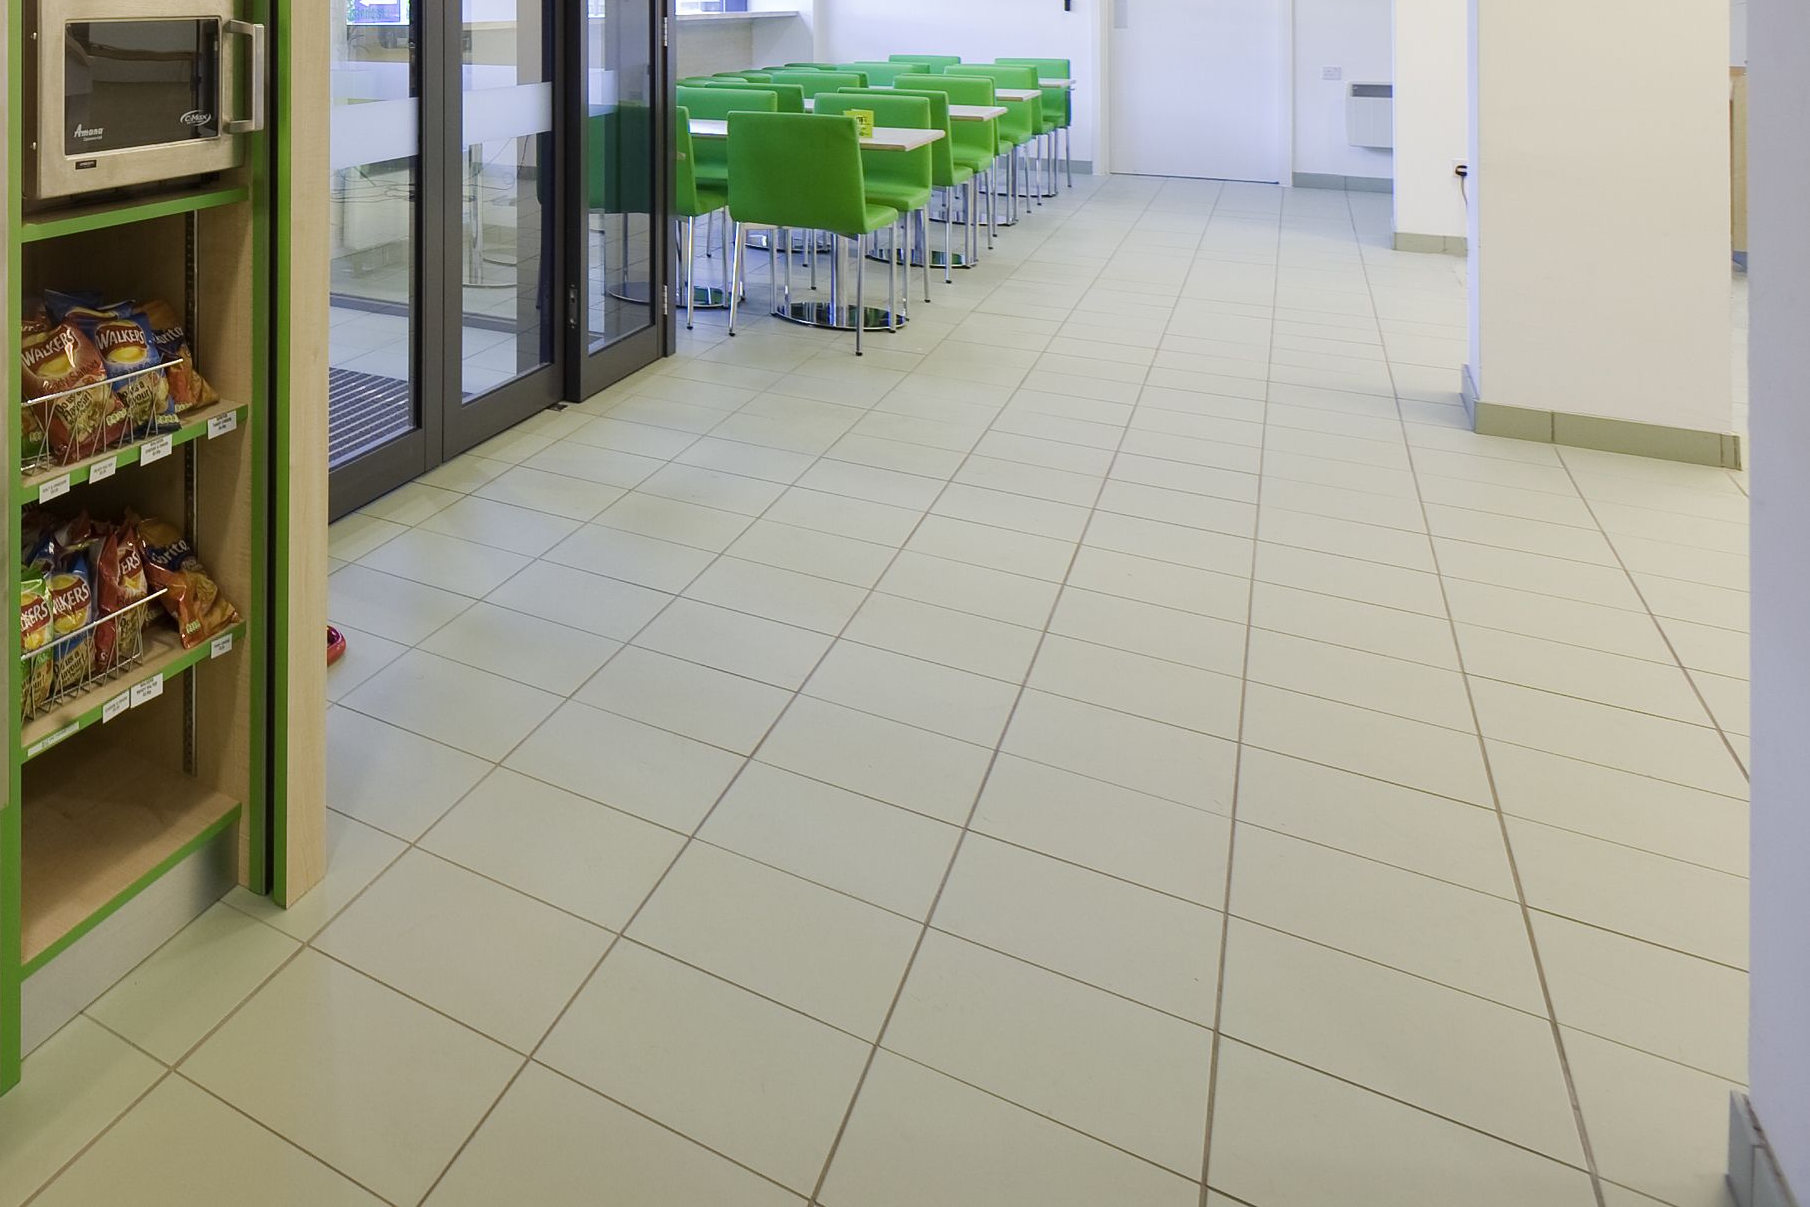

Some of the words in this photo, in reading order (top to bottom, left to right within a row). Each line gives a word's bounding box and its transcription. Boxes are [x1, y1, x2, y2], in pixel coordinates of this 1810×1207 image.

[74, 124, 105, 138] Amana
[22, 332, 75, 368] WALKERS
[96, 328, 146, 350] WALKERS
